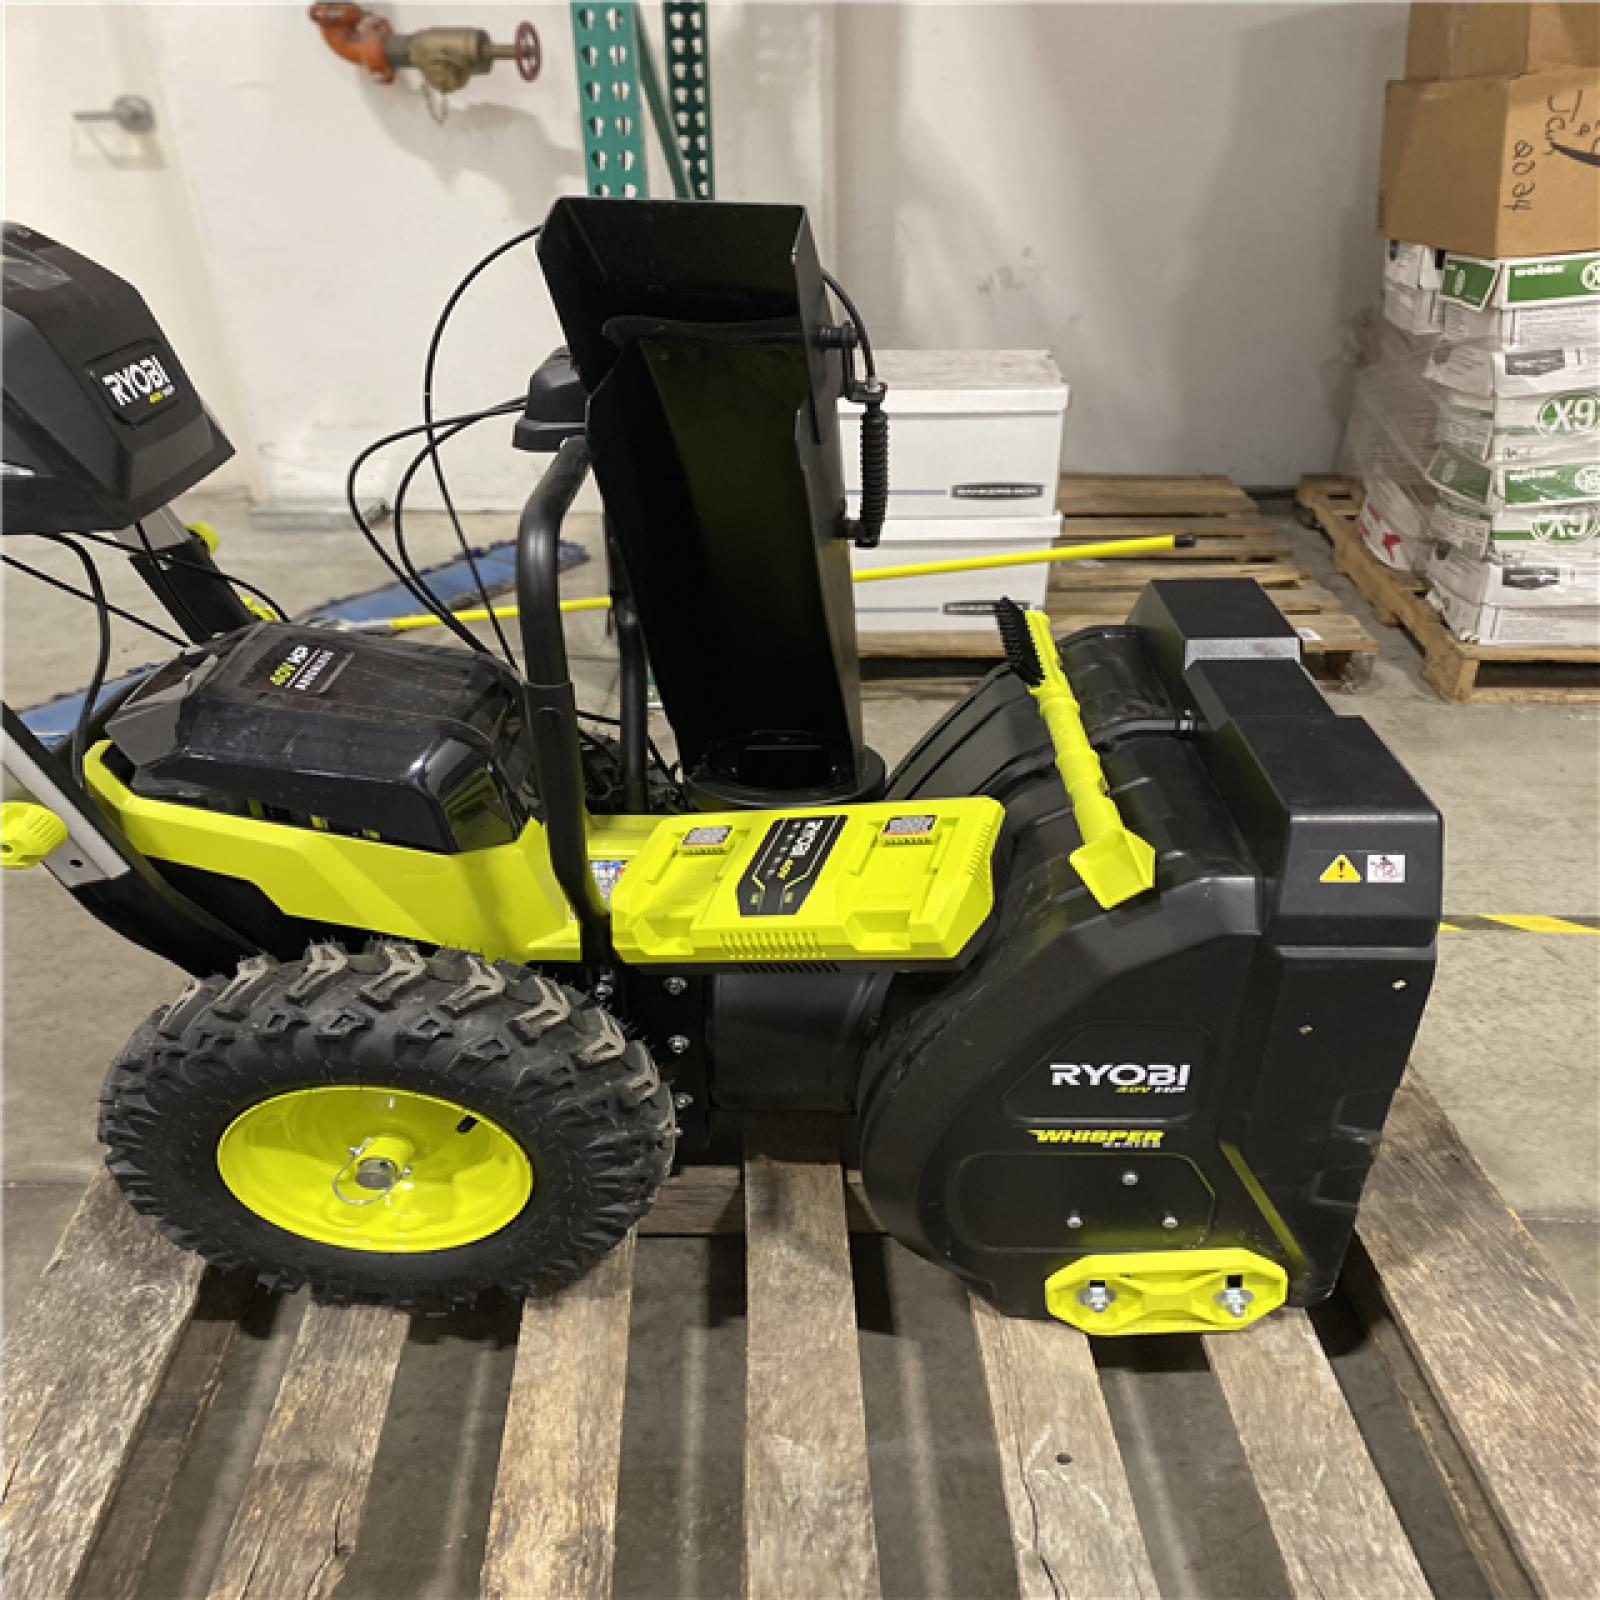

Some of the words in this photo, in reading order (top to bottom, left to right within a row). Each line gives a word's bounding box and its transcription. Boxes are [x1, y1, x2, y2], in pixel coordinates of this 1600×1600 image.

[102, 354, 171, 406] RYOBI
[1050, 1064, 1190, 1086] RYOBI
[1027, 1129, 1165, 1143] WHISPER
